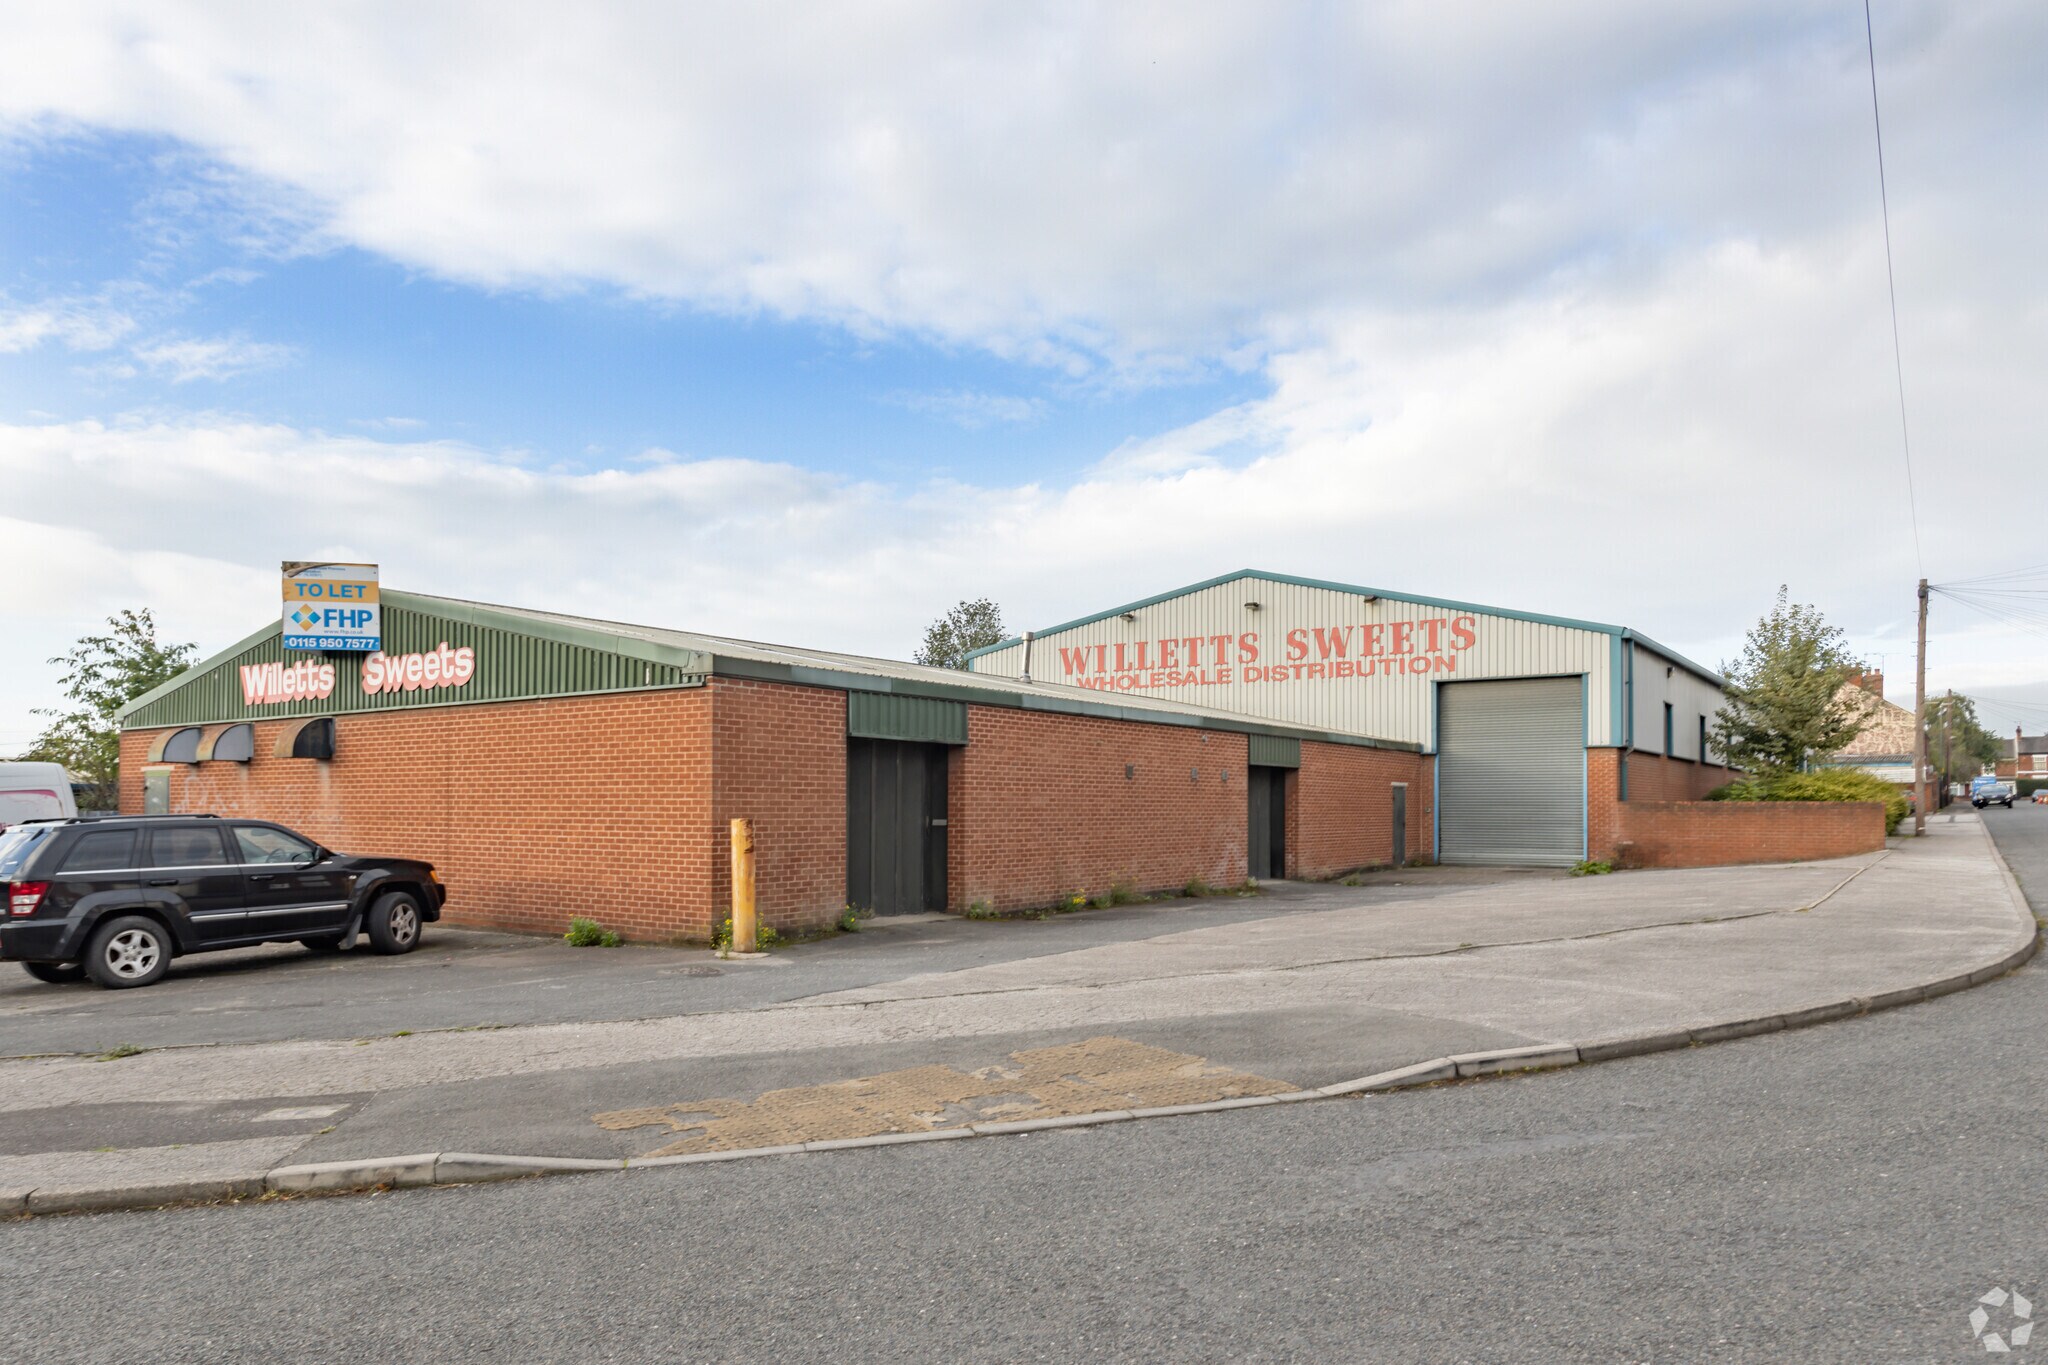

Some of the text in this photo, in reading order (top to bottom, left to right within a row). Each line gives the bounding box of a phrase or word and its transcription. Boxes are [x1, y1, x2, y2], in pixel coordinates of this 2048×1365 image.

[294, 583, 367, 598] TO LET
[323, 608, 373, 628] FHP
[289, 637, 374, 648] 0115 950 7577
[1058, 616, 1475, 675] WILLETTS SWEETS
[241, 642, 474, 703] Willetts Sweets
[1077, 655, 1456, 691] WHOLESALE DISTRIBUTION
